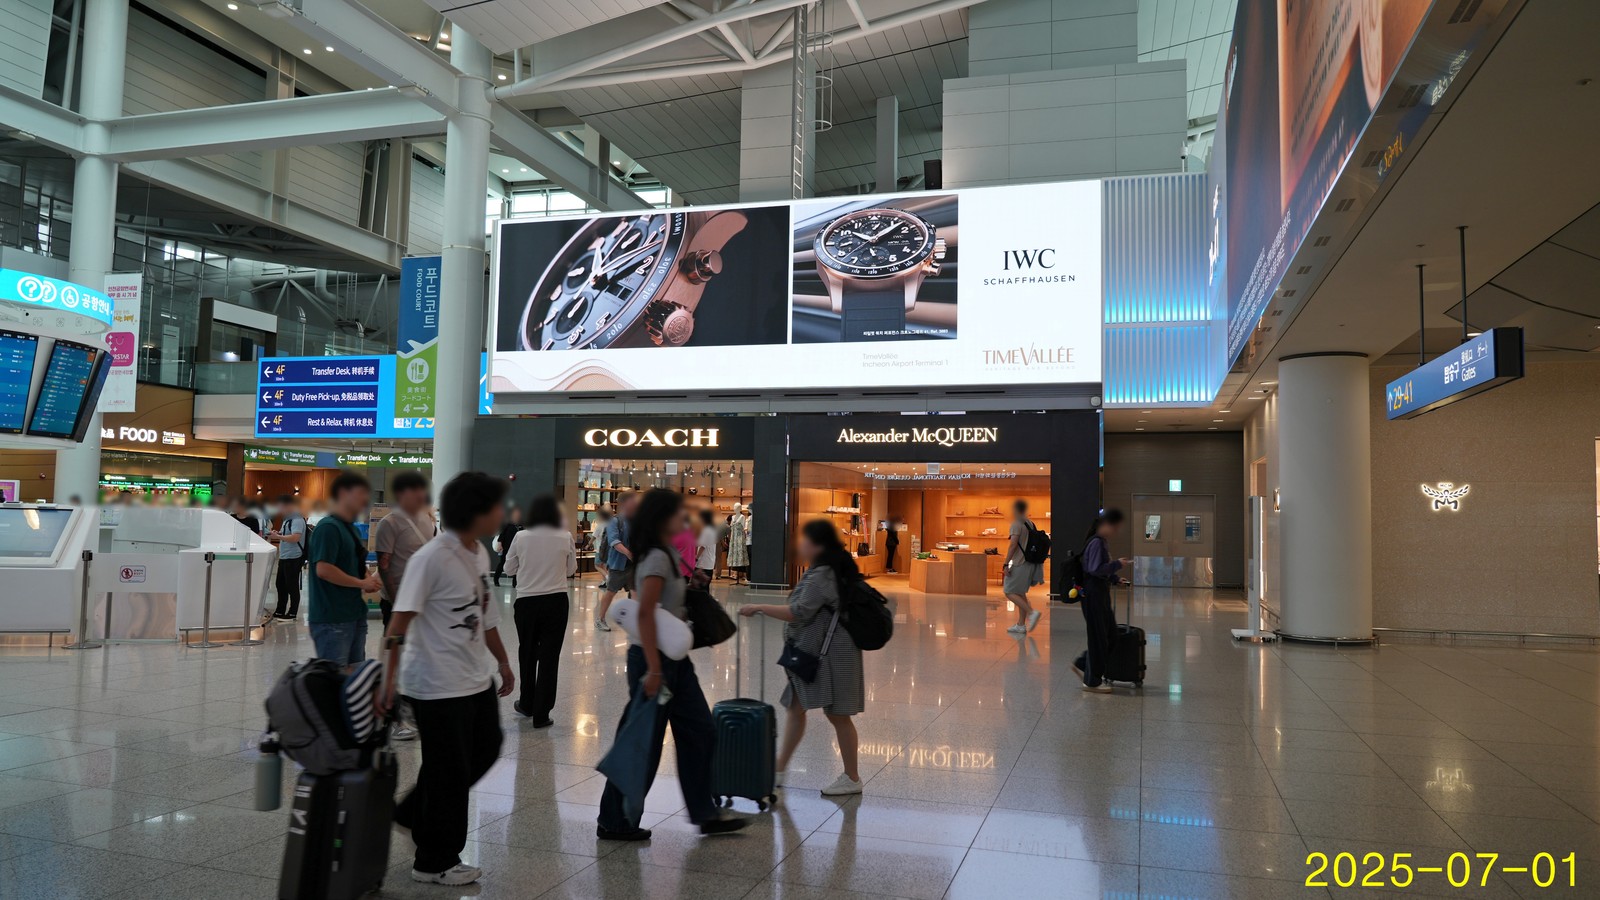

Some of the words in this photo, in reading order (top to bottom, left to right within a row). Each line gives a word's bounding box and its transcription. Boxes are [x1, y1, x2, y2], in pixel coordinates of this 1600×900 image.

[1003, 248, 1056, 270] IWC
[984, 275, 1076, 286] SCHAFFHAUSEN
[424, 268, 438, 328] 푸드코트
[982, 342, 1075, 366] TIMEVALLÉE
[276, 364, 286, 375] 4F
[312, 367, 335, 376] Transfer
[1444, 361, 1459, 384] 탑승구
[1462, 366, 1476, 382] Gates
[274, 390, 284, 400] 4F
[292, 393, 305, 402] Duty
[305, 392, 318, 401] Free
[1393, 380, 1413, 410] 29-41
[273, 415, 282, 425] 4F
[307, 418, 320, 426] Rest
[320, 418, 325, 426] &
[356, 418, 374, 427] 休息处
[120, 426, 158, 442] FOOD
[584, 428, 720, 447] COACH
[837, 428, 909, 443] Alexander
[912, 428, 998, 446] McQUEEN
